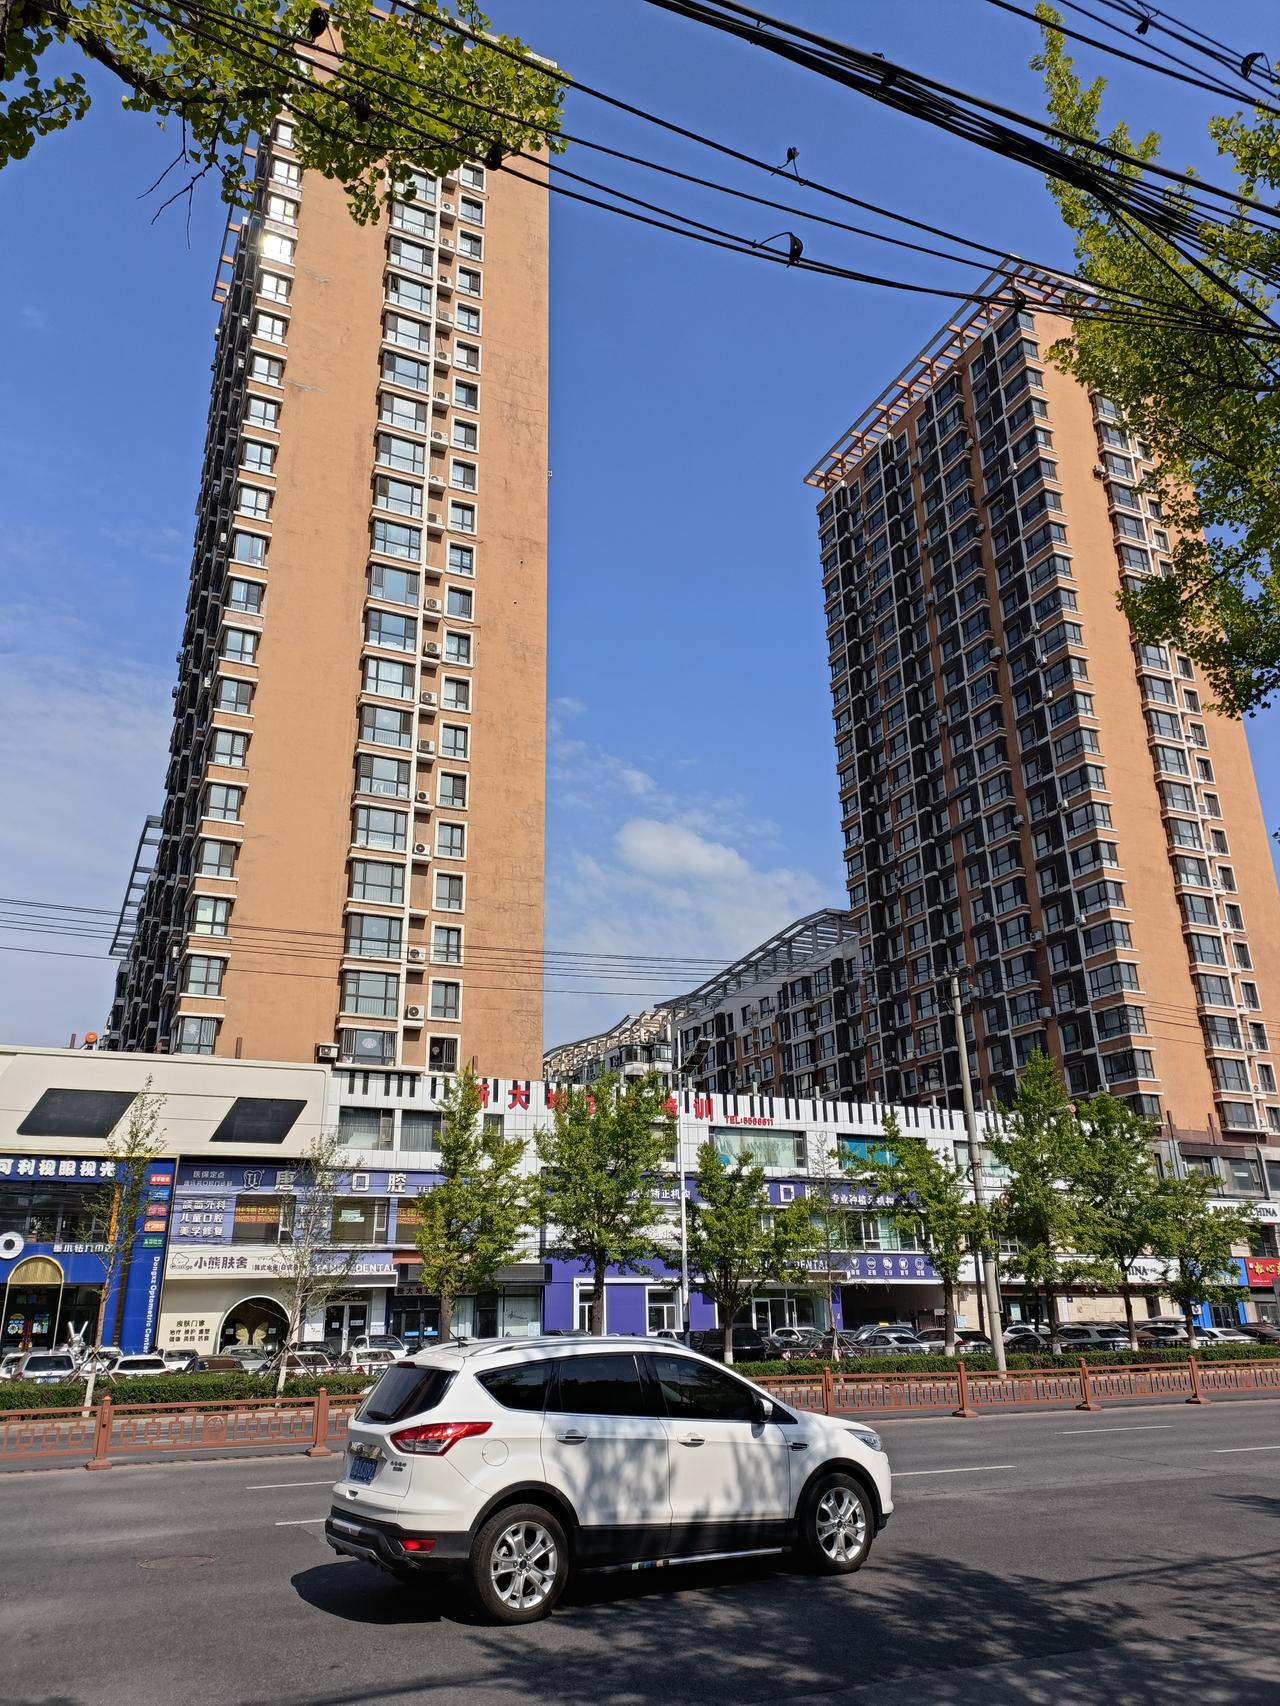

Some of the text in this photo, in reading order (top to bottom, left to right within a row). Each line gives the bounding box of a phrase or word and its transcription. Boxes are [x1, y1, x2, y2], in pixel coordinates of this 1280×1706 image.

[1250, 1207, 1278, 1217] CHINA
[180, 1213, 224, 1224] 儿童口腔
[194, 1256, 248, 1270] 小熊肤舍
[356, 1264, 397, 1273] DENTAL
[146, 1285, 157, 1327] Optometric
